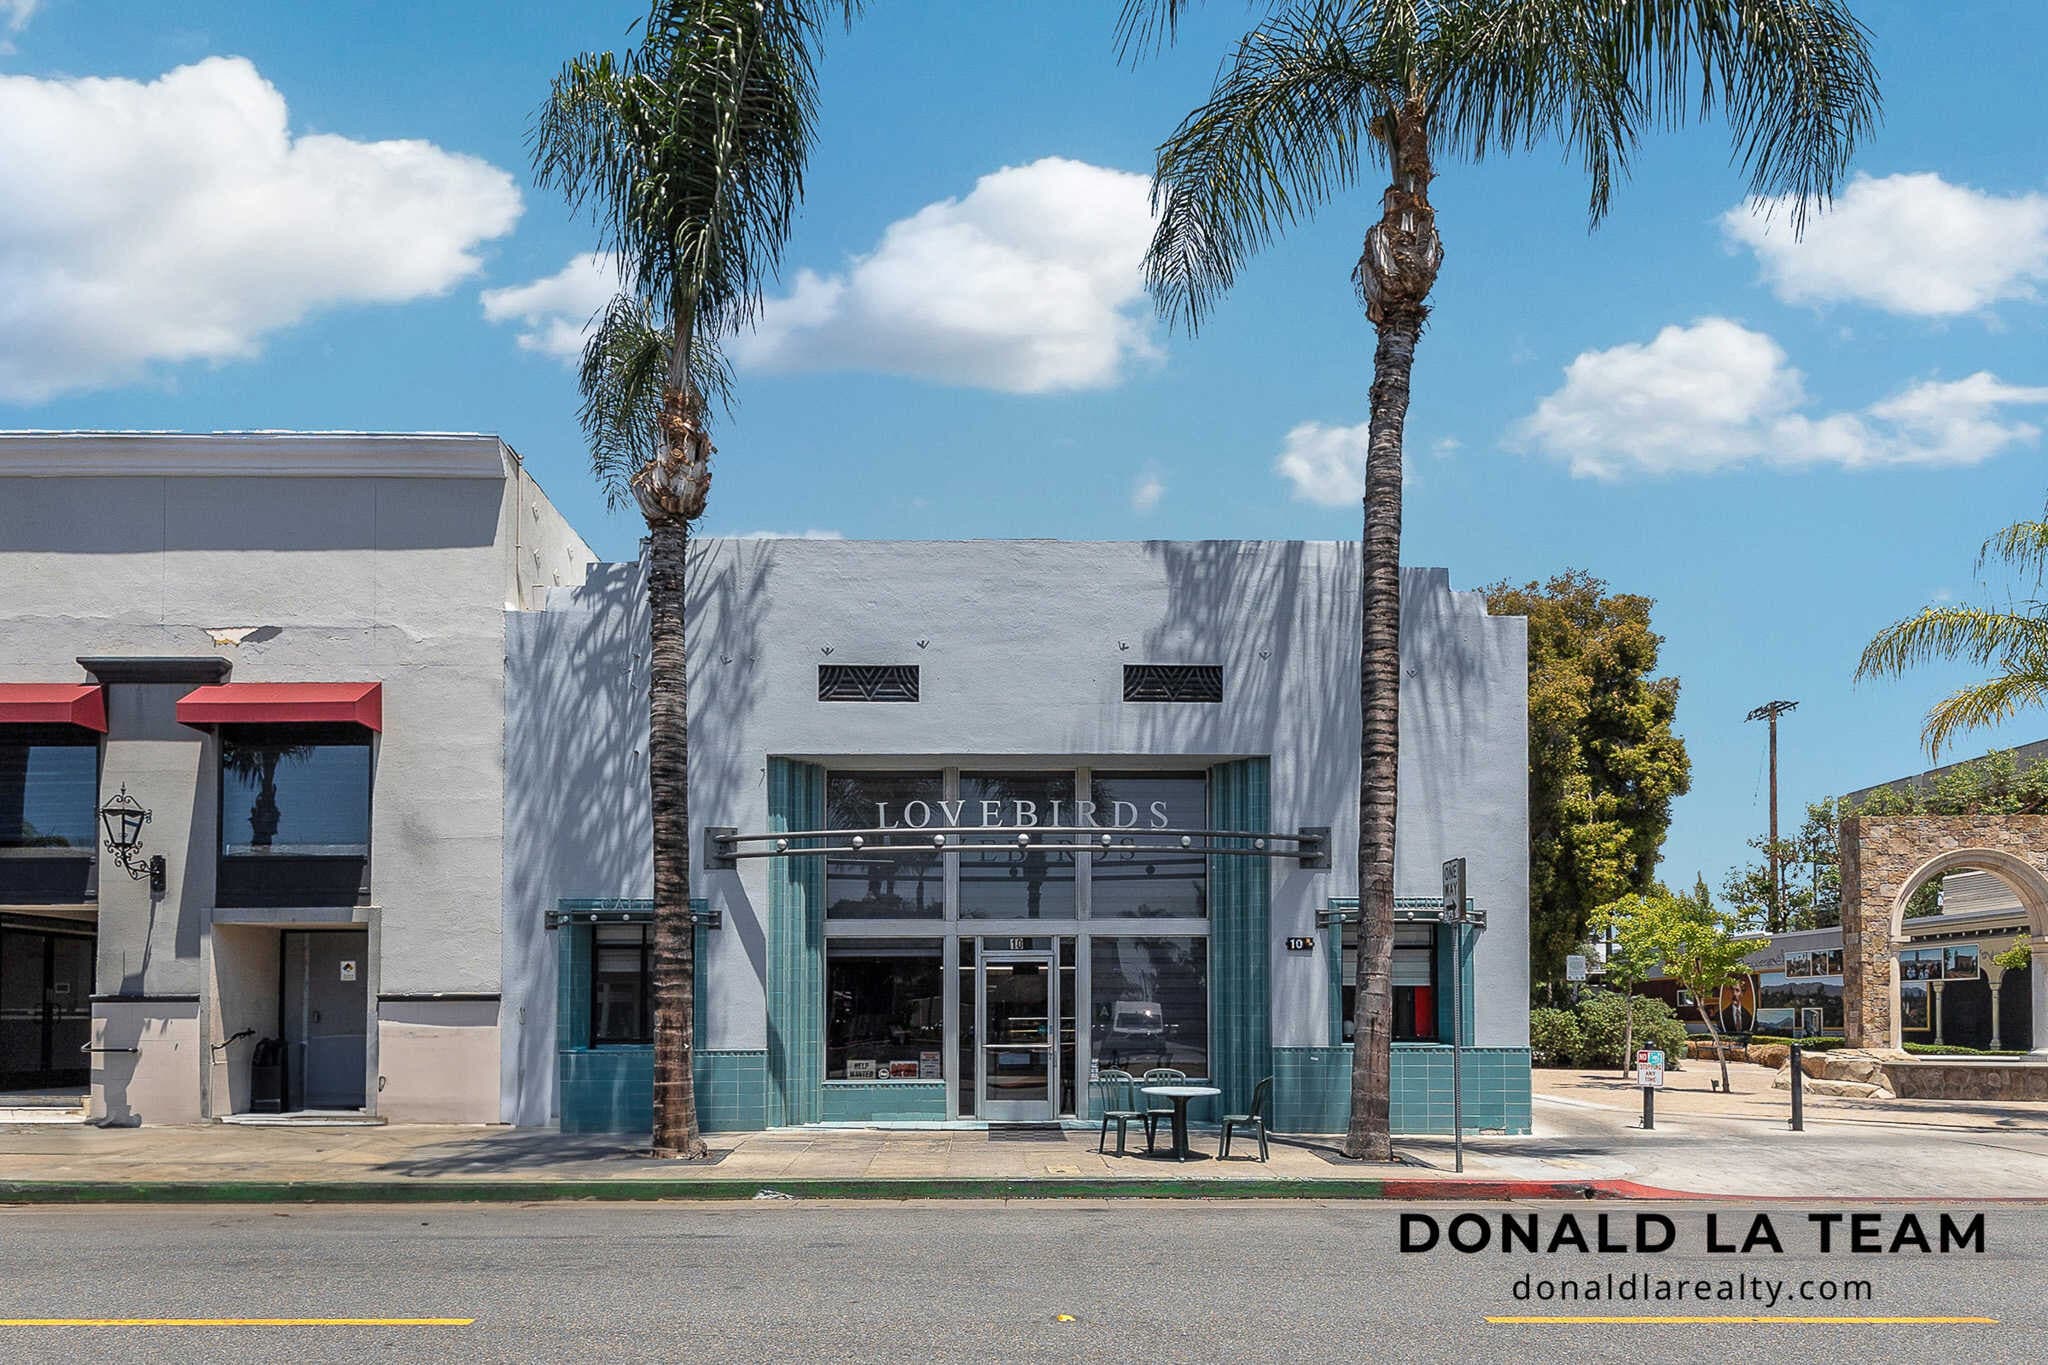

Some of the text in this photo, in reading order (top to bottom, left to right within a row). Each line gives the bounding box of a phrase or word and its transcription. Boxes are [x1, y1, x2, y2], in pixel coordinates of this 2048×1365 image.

[875, 799, 1169, 829] LOVEBIRDS
[1444, 862, 1457, 880] ONE
[1445, 880, 1457, 898] WAY
[1010, 937, 1024, 950] 10
[1290, 939, 1303, 949] 10
[1639, 1053, 1647, 1061] NO
[854, 1062, 870, 1070] HELP
[849, 1070, 874, 1078] WANTED
